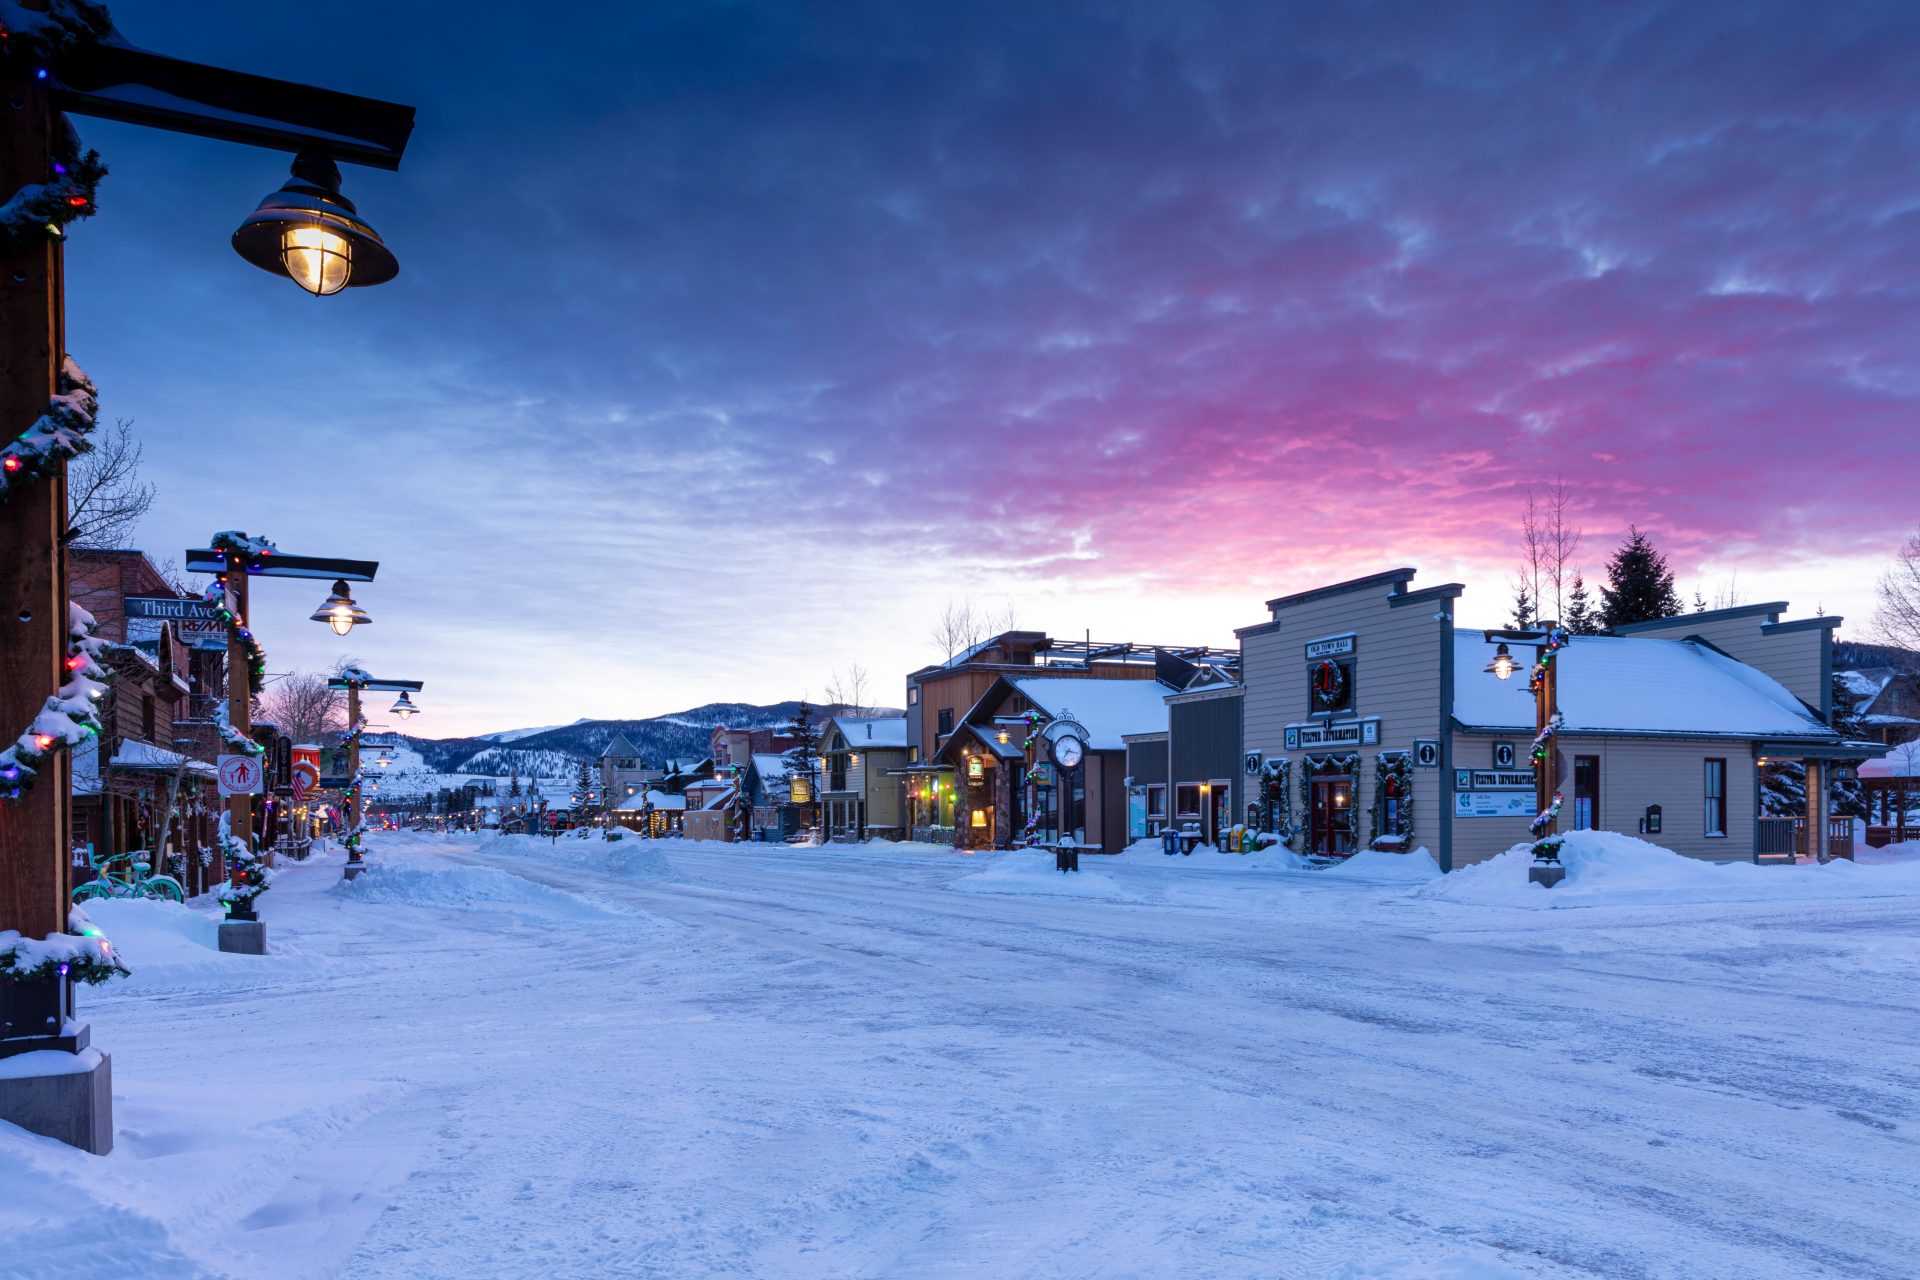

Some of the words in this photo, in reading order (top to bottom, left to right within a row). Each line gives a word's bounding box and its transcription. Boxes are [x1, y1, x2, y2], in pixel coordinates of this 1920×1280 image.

[141, 601, 184, 617] Third
[188, 603, 216, 618] Ave
[1322, 727, 1358, 742] INFORMATION
[1475, 774, 1497, 785] VISITOR
